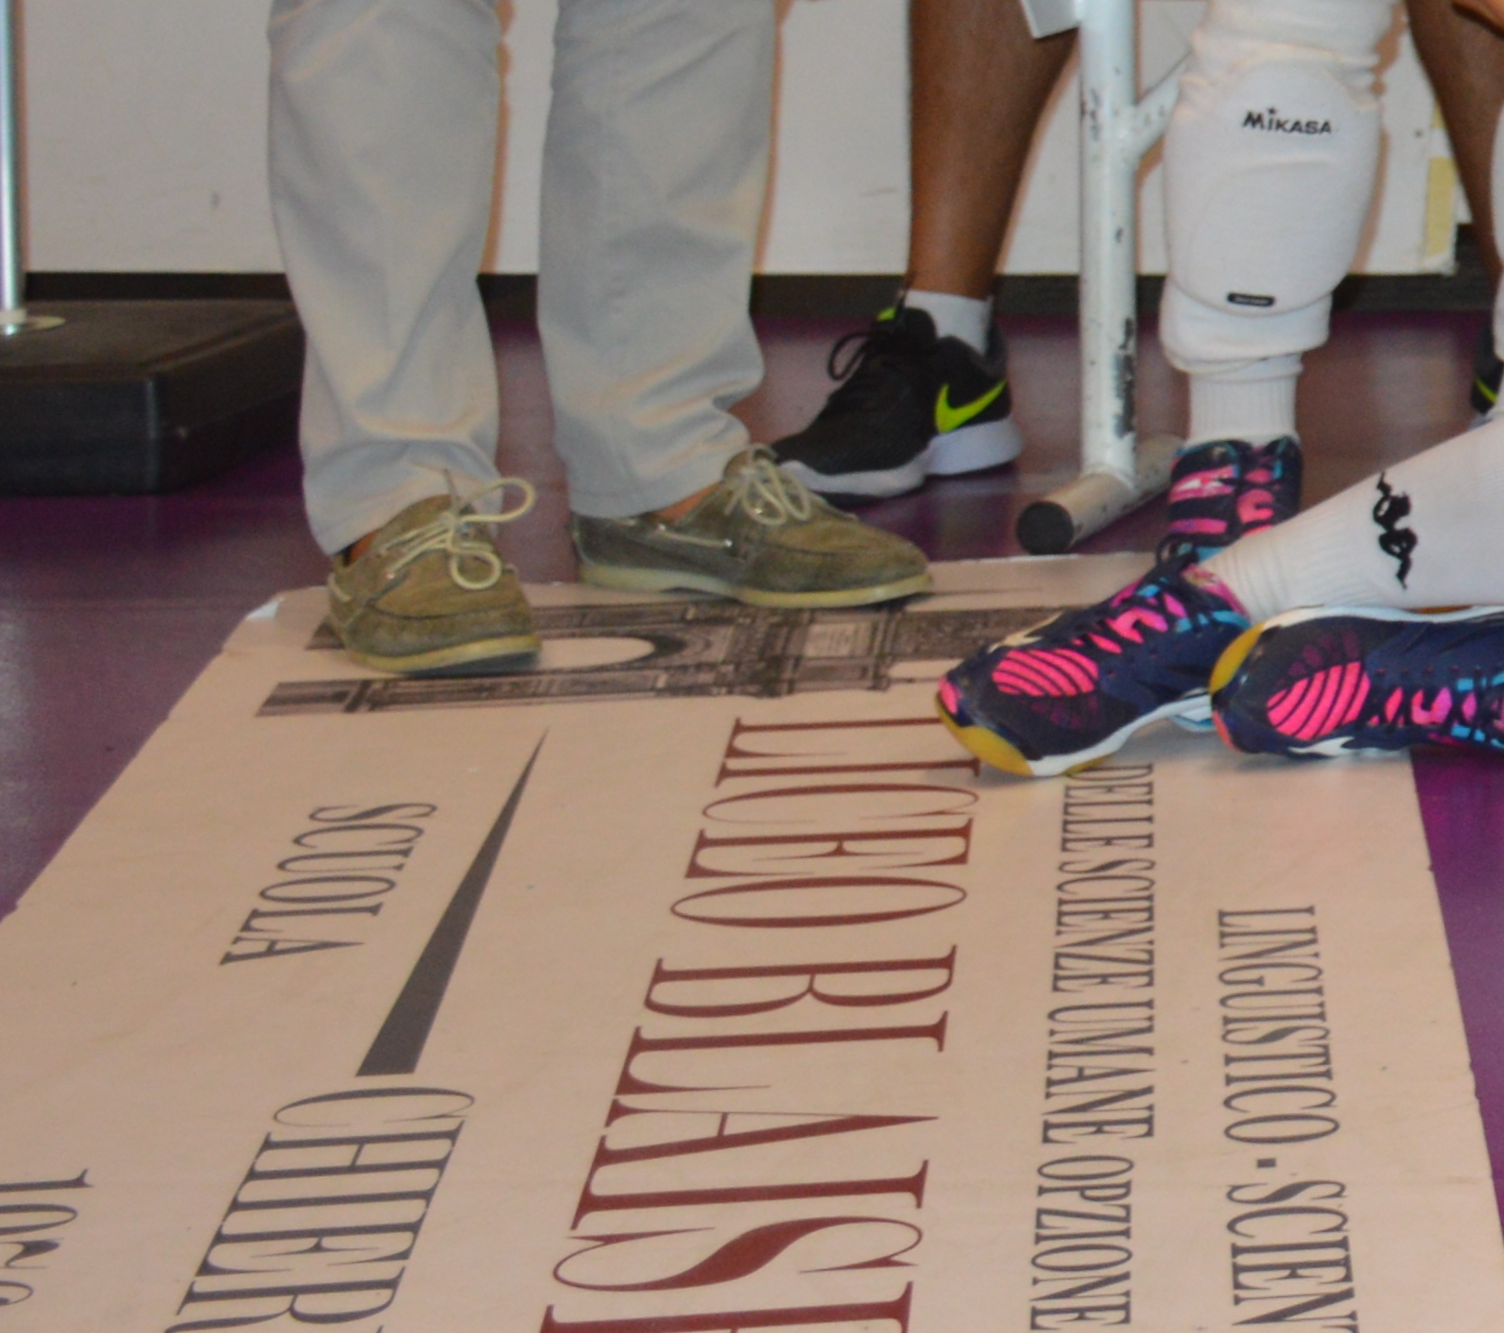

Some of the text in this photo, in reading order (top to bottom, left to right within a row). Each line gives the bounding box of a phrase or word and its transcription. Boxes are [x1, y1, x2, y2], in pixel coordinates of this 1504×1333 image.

[1242, 107, 1333, 136] MIKASA
[219, 802, 438, 965] SCUOLA
[541, 717, 981, 1333] LICEO BLAIS
[1030, 763, 1156, 1333] DELLE SCIENZE UMANE OPZIONE
[1217, 904, 1340, 1145] LINGUISTICO
[163, 1087, 476, 1333] CHIER
[1226, 1179, 1359, 1333] SCIEN
